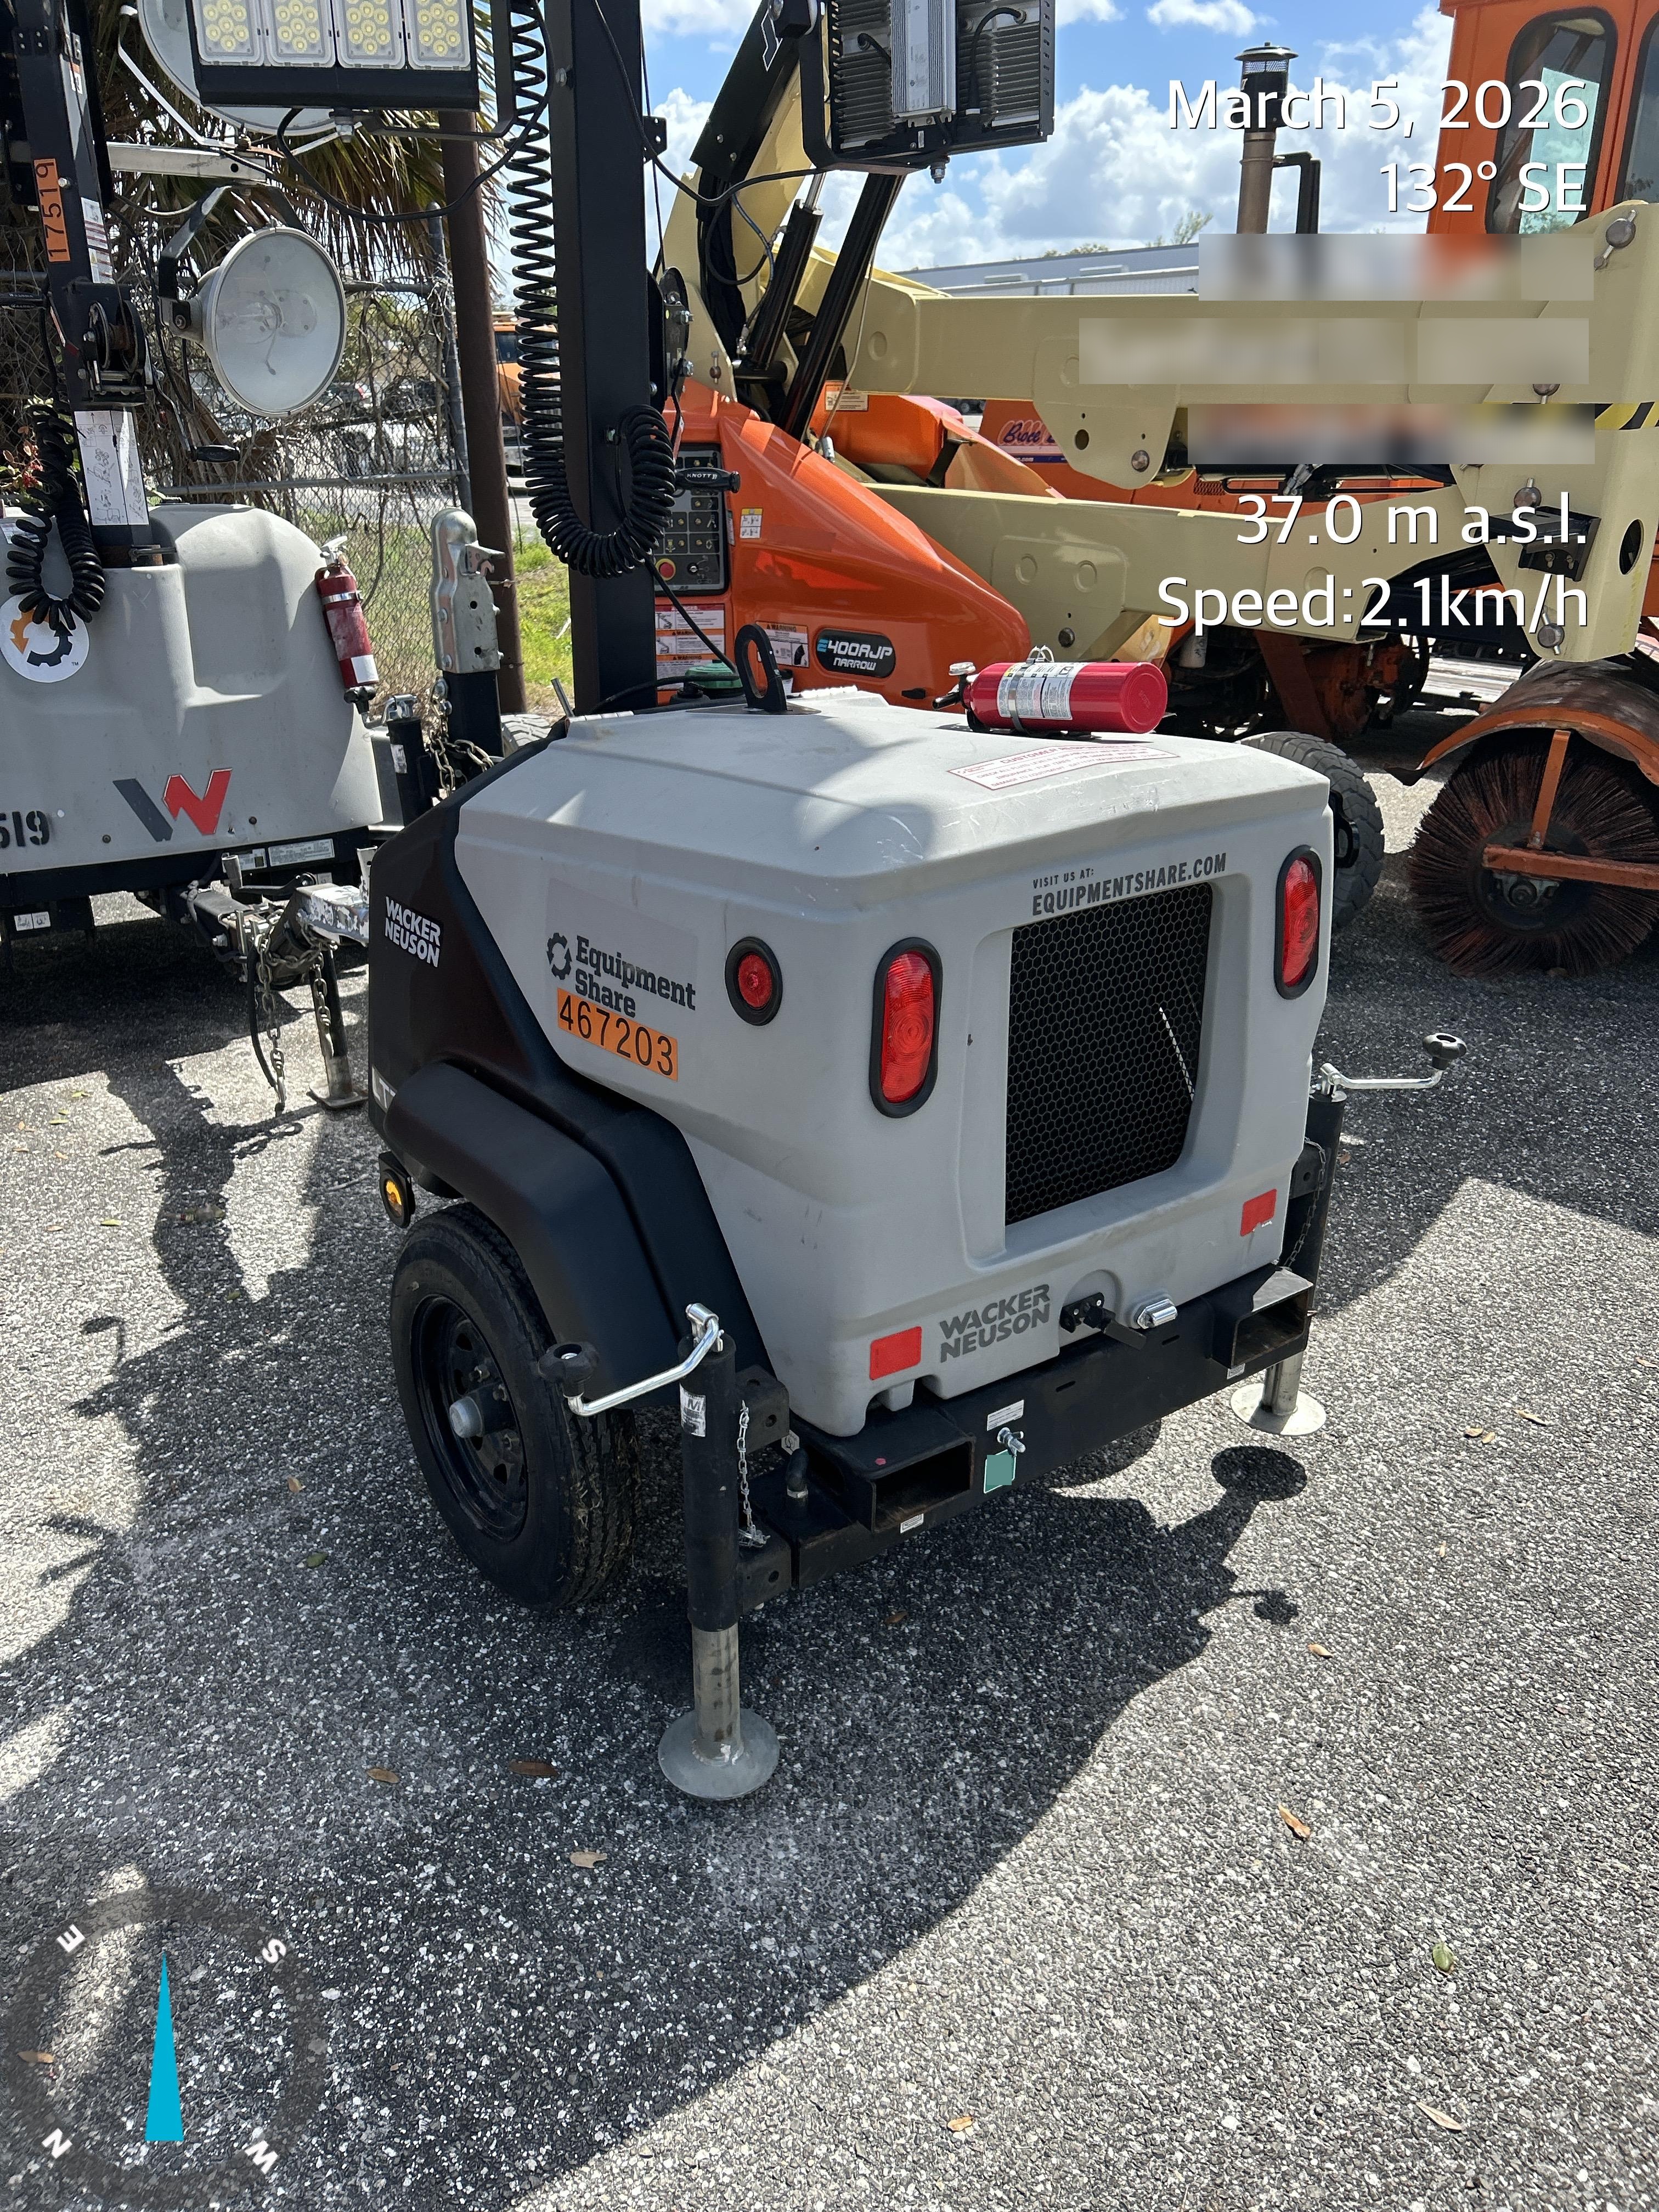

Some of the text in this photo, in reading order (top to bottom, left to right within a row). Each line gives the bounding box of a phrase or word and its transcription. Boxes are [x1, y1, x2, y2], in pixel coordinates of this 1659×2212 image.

[36, 162, 67, 257] 17519
[816, 638, 894, 660] E400AJP
[833, 657, 877, 671] NARROW
[1001, 748, 1056, 764] CUSTOMER
[1032, 868, 1094, 890] VISIT US AT:
[1032, 853, 1227, 917] EQUIPMENTSHARE.COM
[385, 896, 441, 947] WACKER
[385, 916, 441, 968] NEUSON
[575, 969, 636, 1018] Share
[577, 934, 696, 1012] Equipment
[559, 994, 674, 1077] 467203
[939, 1284, 1051, 1340] WACKER
[940, 1303, 1051, 1363] NEUSON
